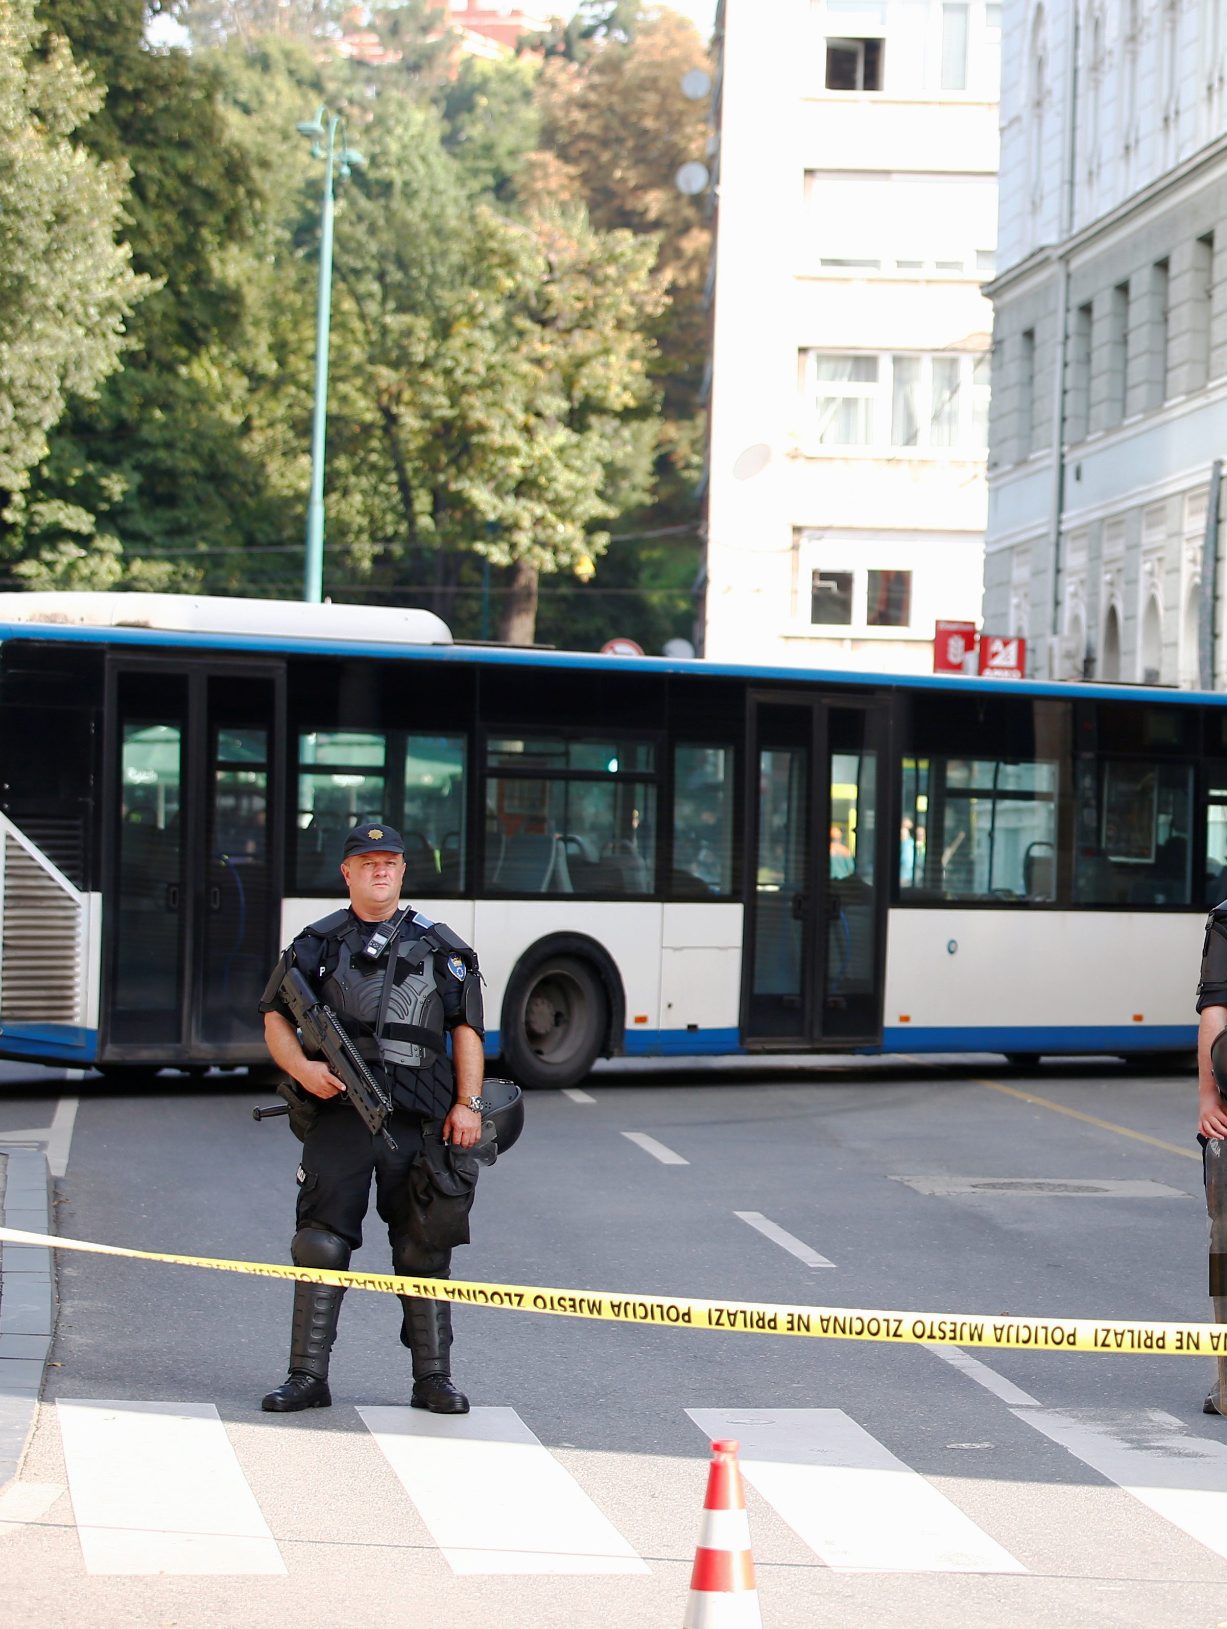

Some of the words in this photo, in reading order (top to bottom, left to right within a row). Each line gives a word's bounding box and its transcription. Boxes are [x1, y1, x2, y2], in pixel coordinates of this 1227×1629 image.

[338, 1276, 406, 1295] PRILAZI
[413, 1284, 437, 1298] NE
[444, 1287, 524, 1307] ZLOCINA
[533, 1294, 602, 1316] MJESTO
[610, 1300, 692, 1324] POLICIJA
[708, 1308, 778, 1330] PRILAZI
[787, 1313, 810, 1332] NE
[820, 1315, 903, 1338] ZLOCINA
[912, 1319, 984, 1342] MJESTO
[993, 1323, 1077, 1346] POLICIJA
[1094, 1327, 1166, 1349] PRILAZI
[1175, 1331, 1200, 1350] NE
